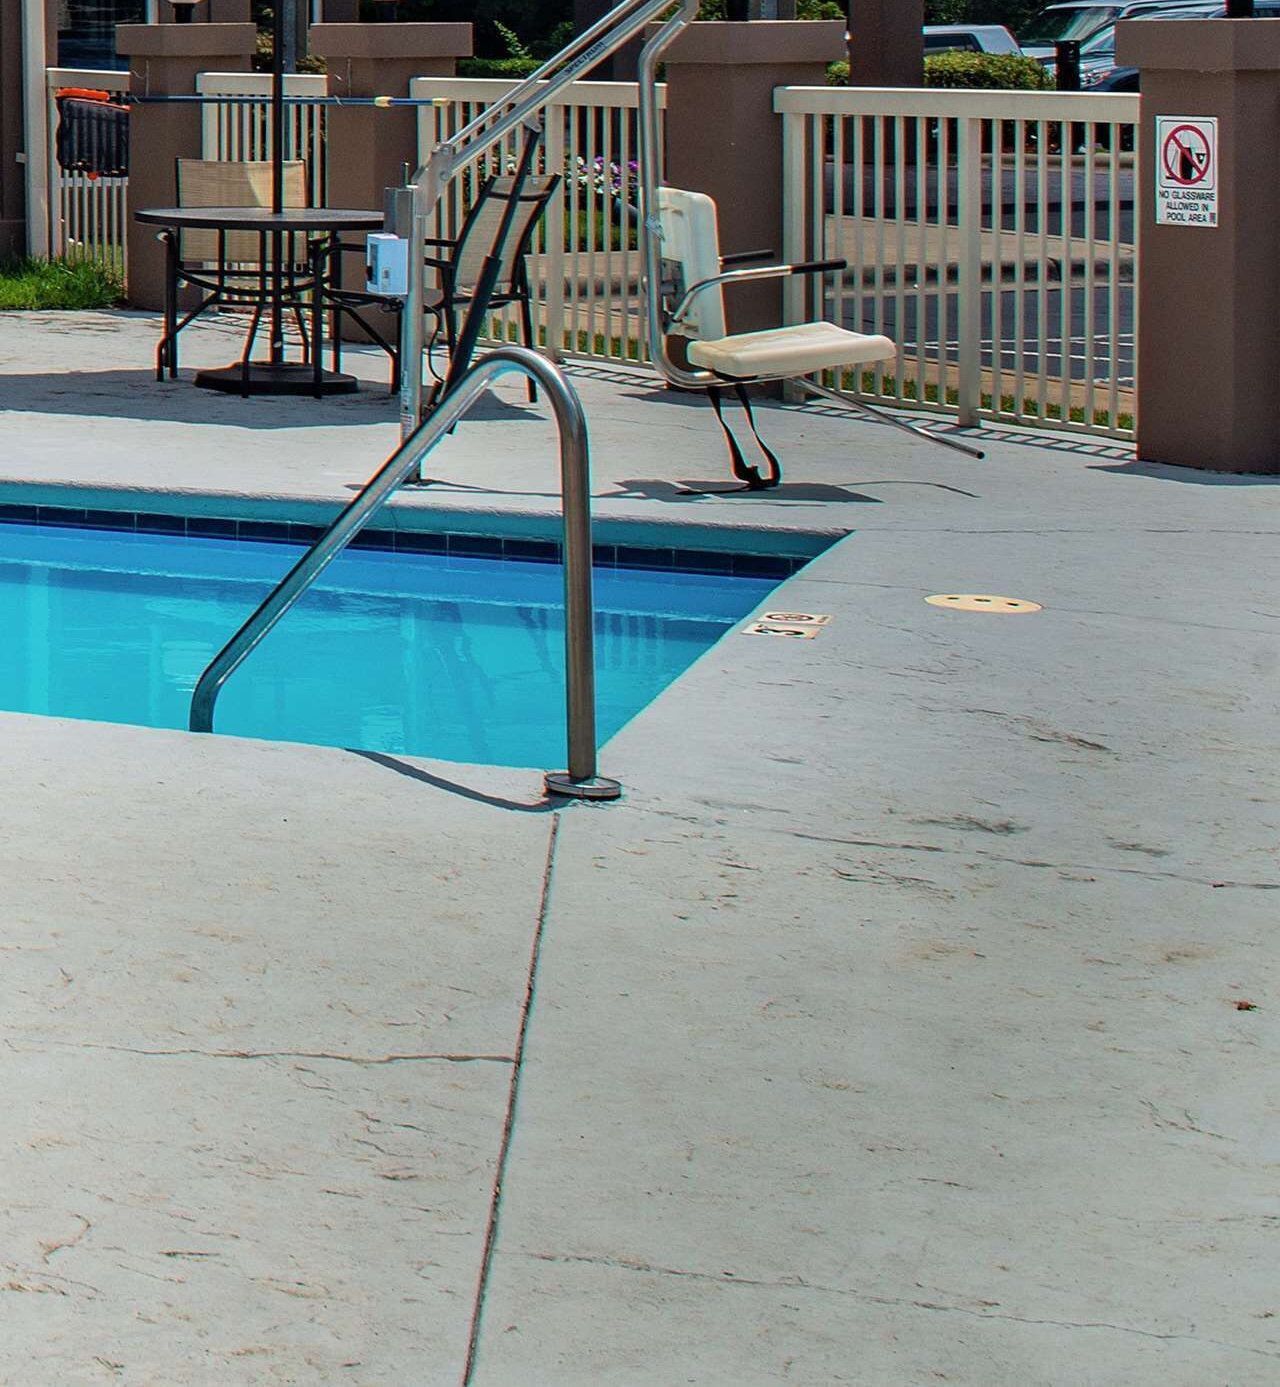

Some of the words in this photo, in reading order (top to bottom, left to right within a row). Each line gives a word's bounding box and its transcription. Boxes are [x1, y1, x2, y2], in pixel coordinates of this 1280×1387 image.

[1159, 190, 1170, 199] NO
[1172, 190, 1216, 202] GLASSWARE
[1166, 201, 1200, 212] ALLOWED
[1201, 203, 1209, 212] IN
[1167, 212, 1186, 222] POOL
[1188, 213, 1207, 223] AREA
